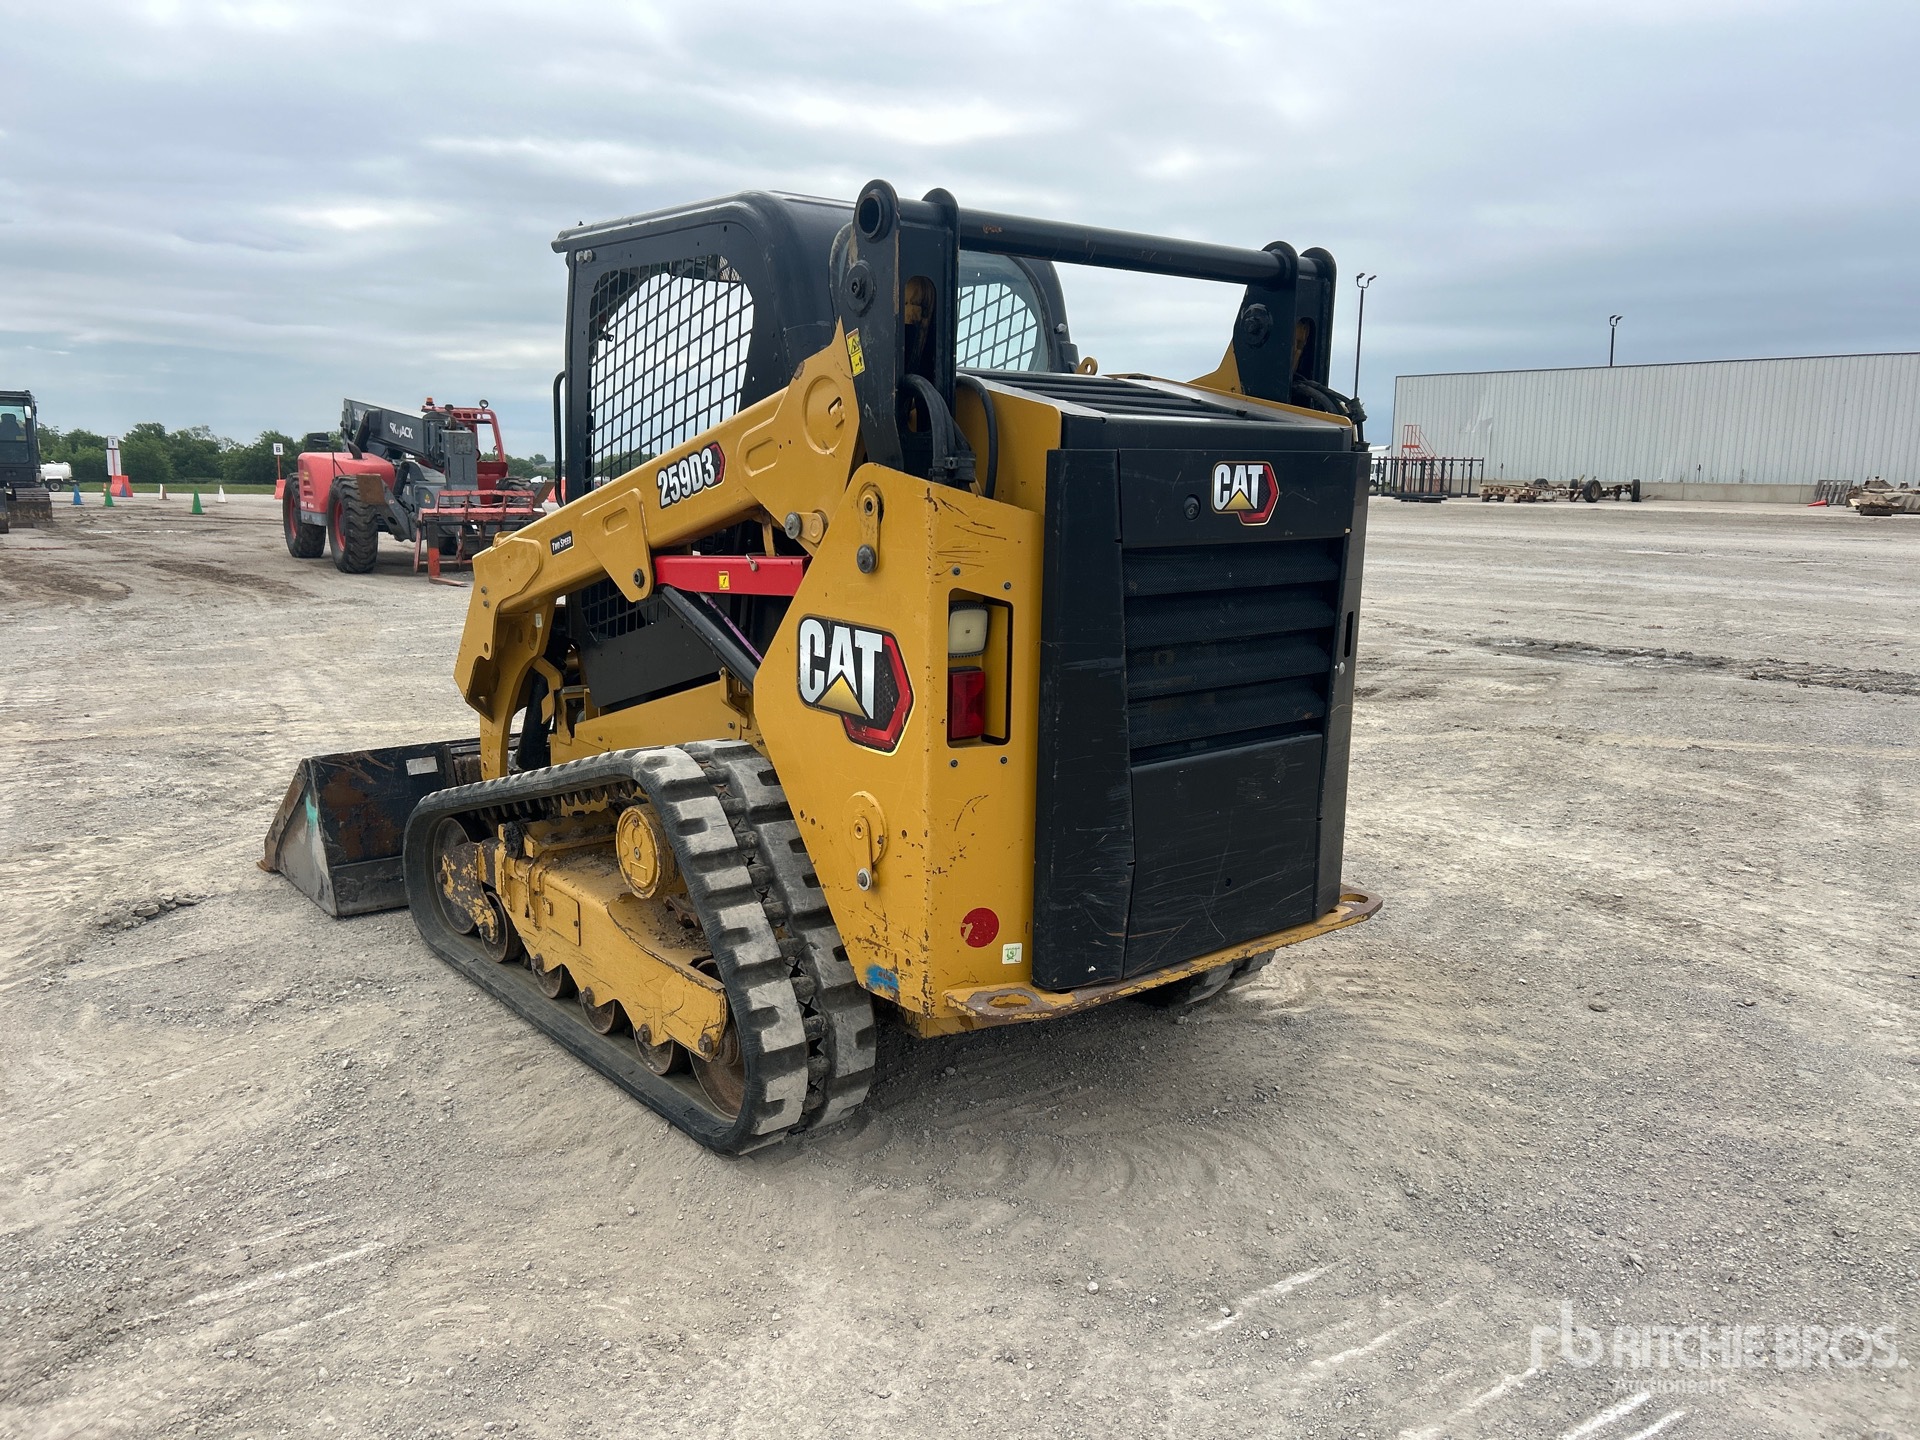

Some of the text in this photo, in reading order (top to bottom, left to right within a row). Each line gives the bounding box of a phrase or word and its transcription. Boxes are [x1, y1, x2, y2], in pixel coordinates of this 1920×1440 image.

[657, 448, 715, 507] 259D3
[1213, 464, 1264, 511] CAT
[799, 618, 883, 720] CAT
